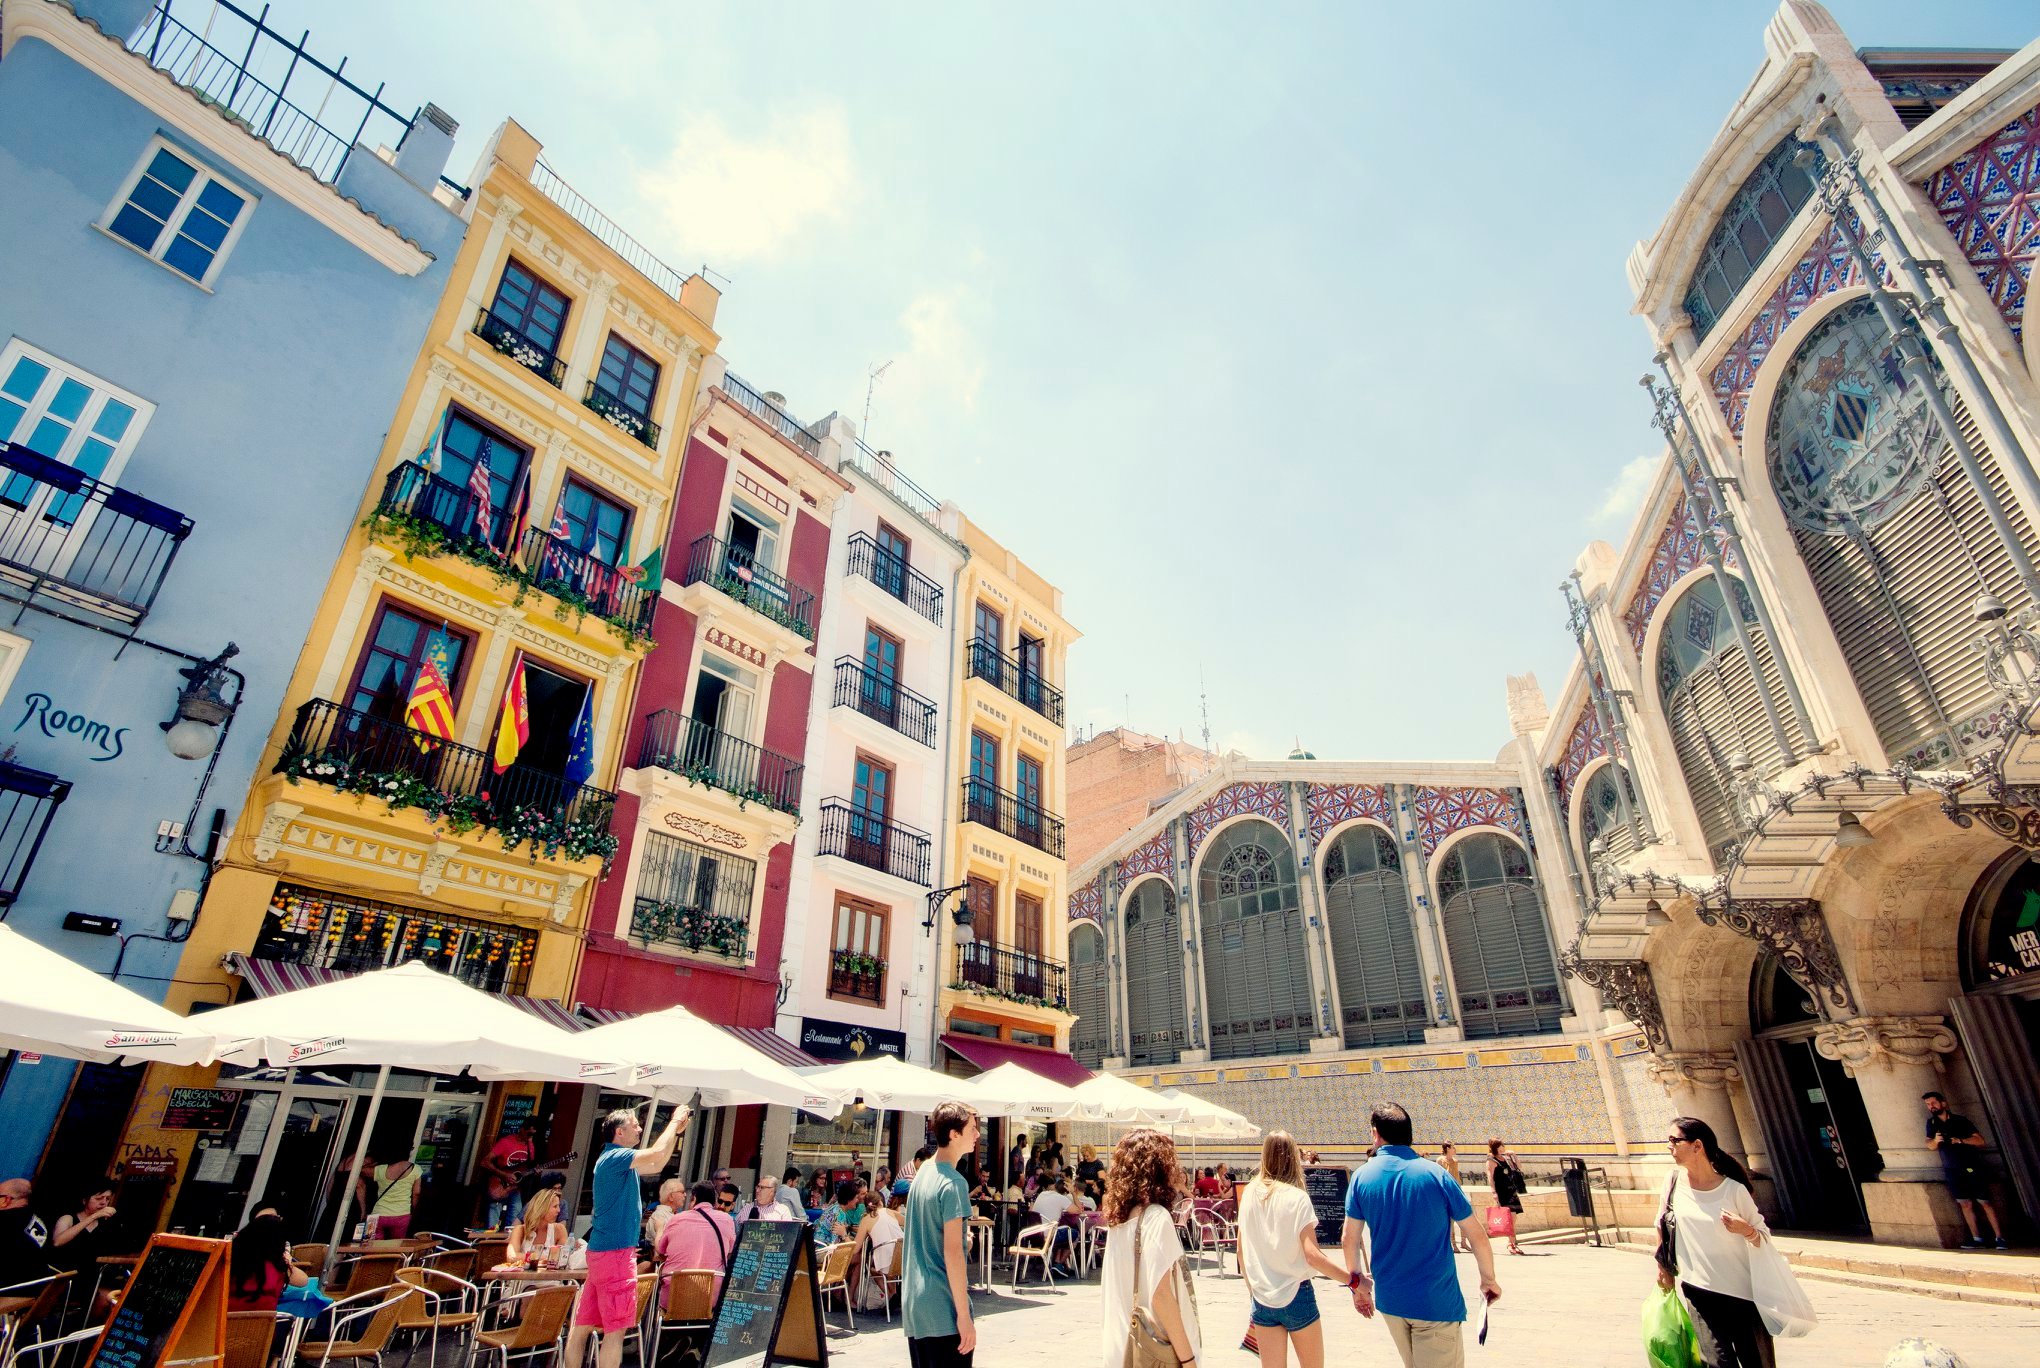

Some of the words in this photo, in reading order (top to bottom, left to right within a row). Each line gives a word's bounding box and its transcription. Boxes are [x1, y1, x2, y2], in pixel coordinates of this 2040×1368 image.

[14, 693, 131, 761] Rooms
[2009, 930, 2040, 952] MER
[804, 1028, 842, 1045] Restaurante
[878, 1043, 899, 1053] AMSTEL
[169, 1099, 212, 1108] ESPECIAL
[174, 1089, 219, 1101] MARISCADA
[220, 1090, 236, 1103] 30
[121, 1143, 177, 1159] TAPAS
